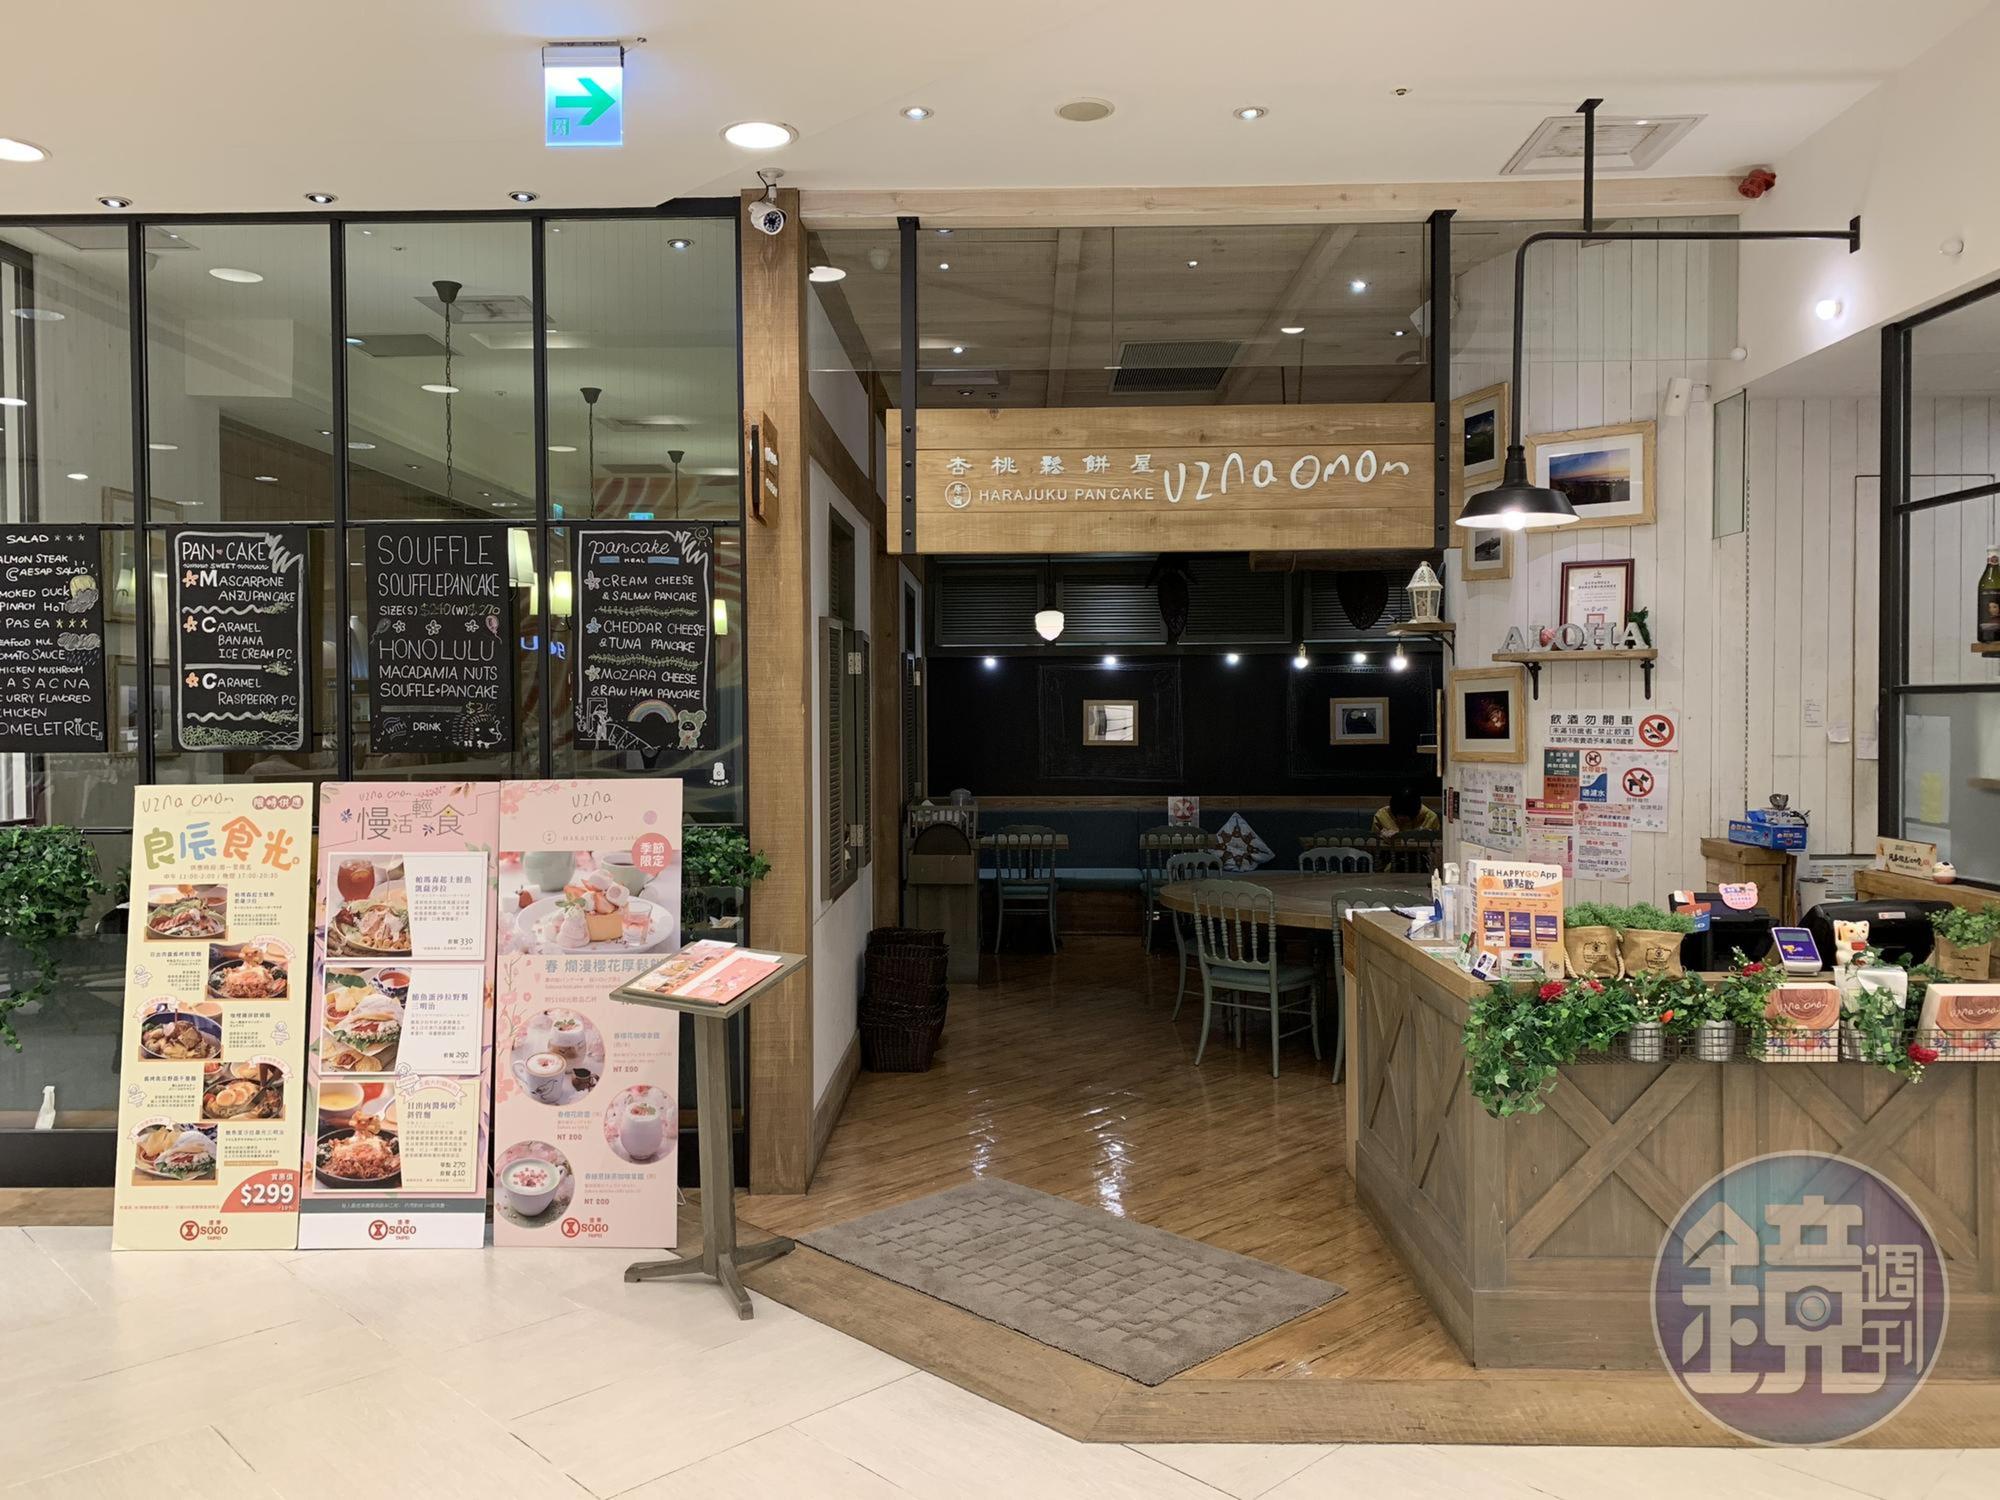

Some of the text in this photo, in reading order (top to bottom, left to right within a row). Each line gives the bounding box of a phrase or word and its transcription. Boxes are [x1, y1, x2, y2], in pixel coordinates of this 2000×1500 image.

[946, 454, 1155, 475] 杏桃鬆餅屋
[979, 488, 1067, 500] HARAJUKU
[6, 534, 49, 544] SALAD
[182, 542, 267, 561] PAN CAKE
[378, 535, 494, 565] SOUFFLE
[36, 553, 68, 563] STEAK
[55, 566, 88, 576] SALAD
[200, 570, 284, 587] MASCARPONE
[655, 575, 694, 585] CHEESE
[612, 591, 651, 601] SALMON
[655, 592, 697, 602] PANCAKE
[201, 617, 261, 633] CARAMEL
[603, 620, 706, 636] CHEDDAR CHEESE
[218, 635, 264, 646] BANANA
[1499, 622, 1650, 652] ALOHA
[380, 638, 495, 660] HONOLULU
[609, 637, 641, 649] TUNA
[651, 638, 695, 653] PANCAKE
[31, 649, 66, 660] SAUCE
[219, 649, 292, 659] ICE CREAM PC
[38, 666, 83, 674] MUSHROOM
[380, 665, 498, 680] MACADAMIA NUTS
[202, 673, 261, 689] CARAMEL
[600, 668, 697, 684] MOZARA CHEESE
[39, 693, 91, 703] FLAVORED
[630, 686, 653, 696] HAM
[657, 688, 701, 699] PANCAKE
[218, 692, 297, 705] RASPBERRY PC
[0, 707, 47, 718] HICKEN
[1550, 714, 1633, 725] 飲酒勿開車
[413, 722, 441, 731] DRINK
[640, 842, 664, 853] 季節
[640, 856, 664, 867] 限定
[1540, 870, 1557, 879] App
[460, 937, 473, 945] 330
[241, 1183, 294, 1206] $299
[200, 1225, 228, 1235] SOGO
[388, 1225, 416, 1235] SOGO
[581, 1223, 609, 1232] SOGO
